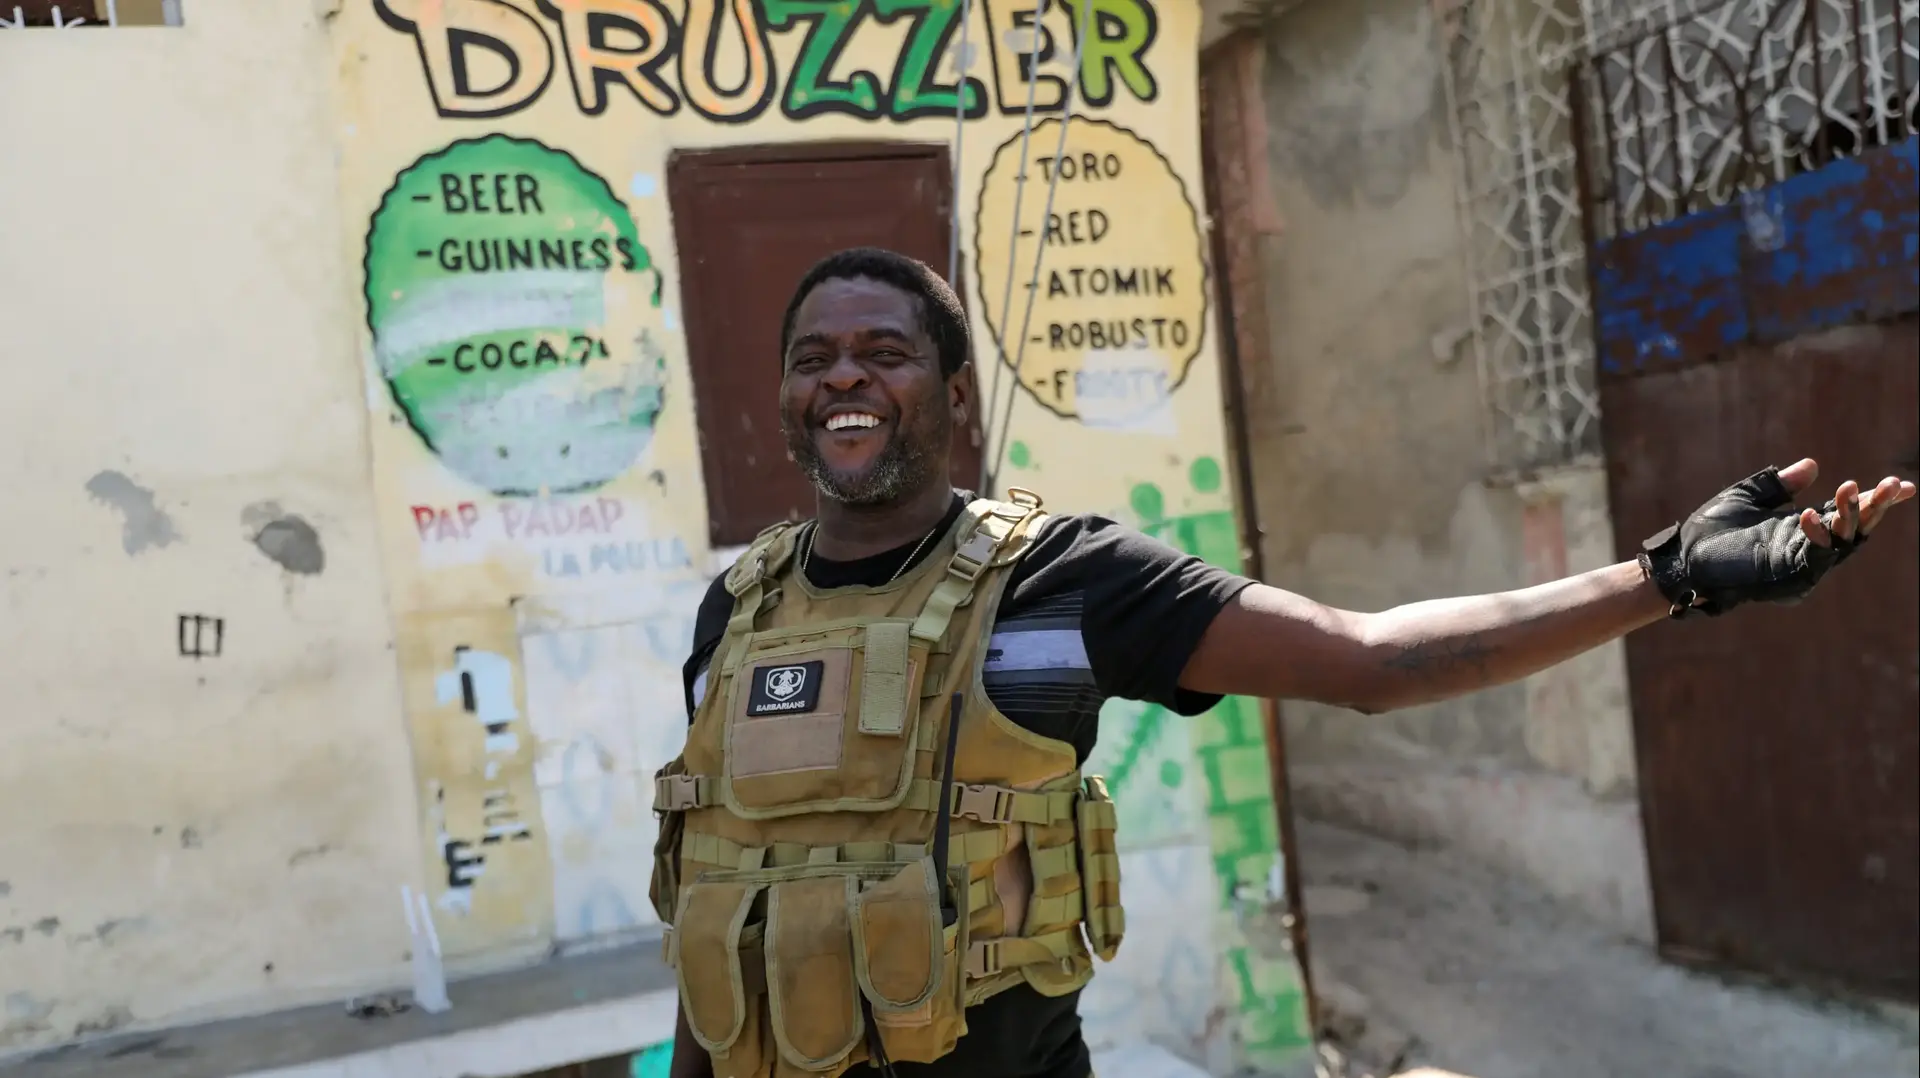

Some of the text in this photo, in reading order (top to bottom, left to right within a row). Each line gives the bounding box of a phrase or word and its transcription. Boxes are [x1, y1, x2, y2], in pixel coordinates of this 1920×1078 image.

[373, 0, 1157, 124] DRUZZER
[411, 501, 480, 542] PAP
[755, 700, 805, 712] BARBARIANS
